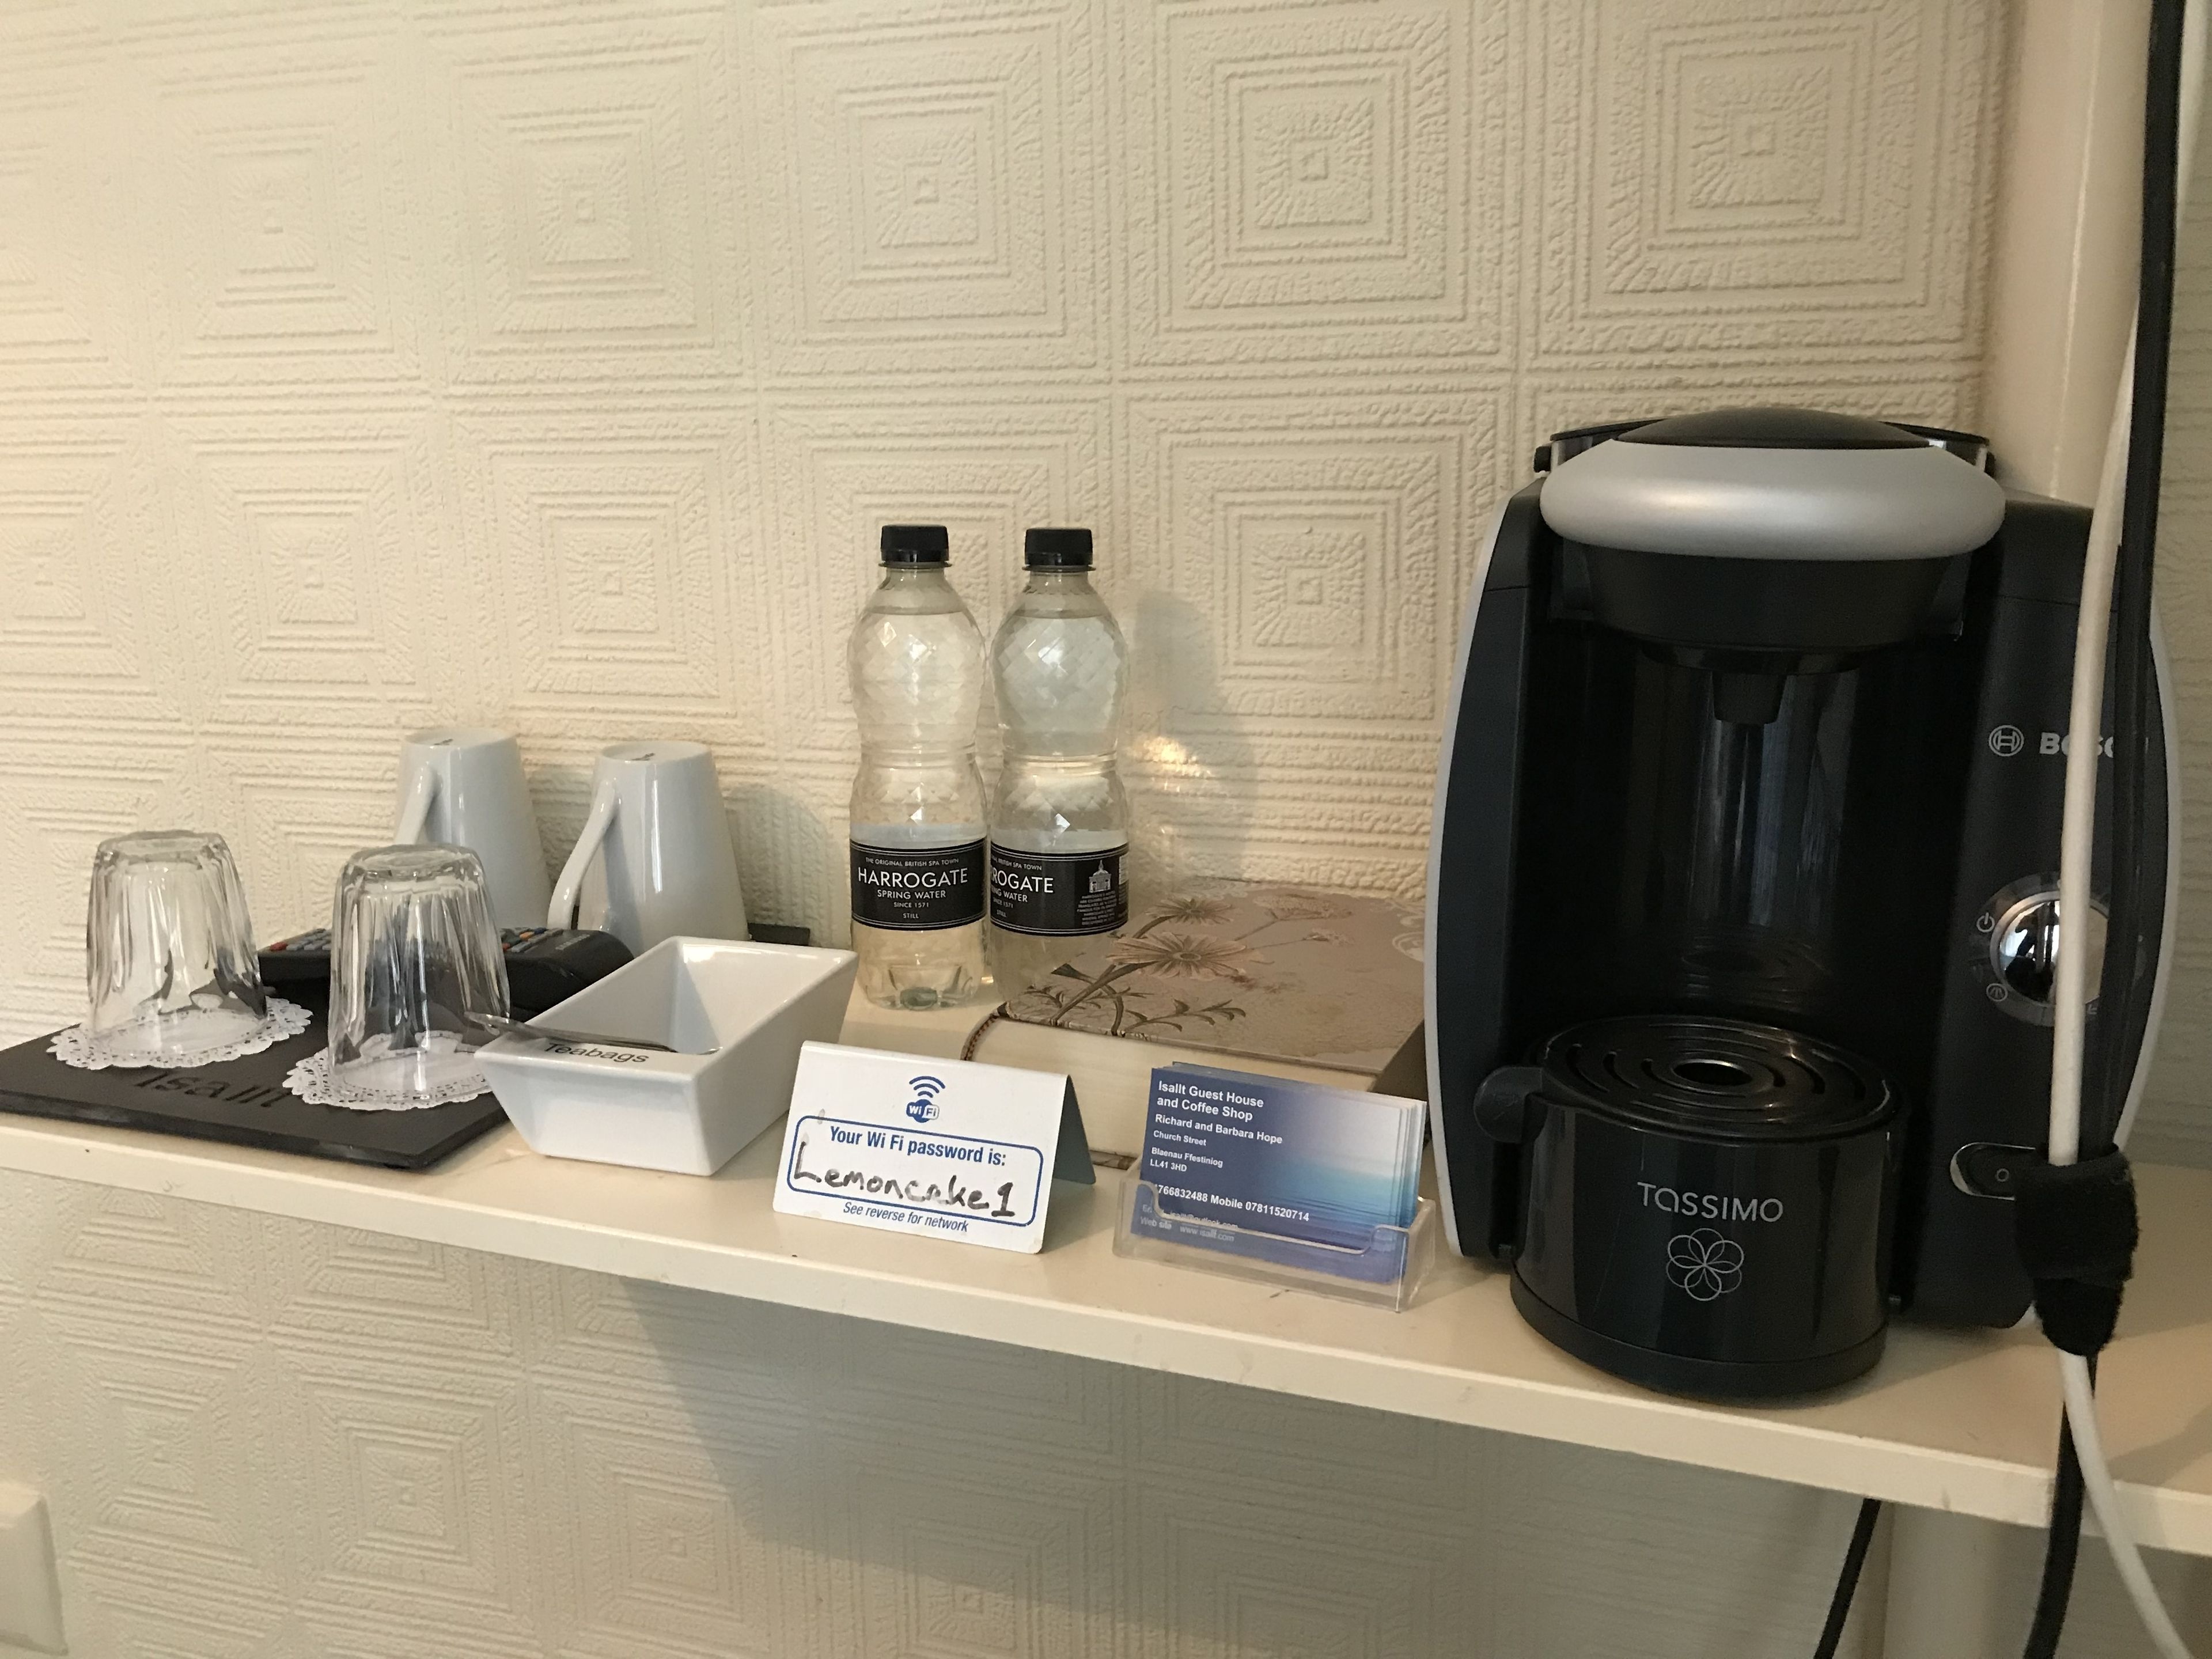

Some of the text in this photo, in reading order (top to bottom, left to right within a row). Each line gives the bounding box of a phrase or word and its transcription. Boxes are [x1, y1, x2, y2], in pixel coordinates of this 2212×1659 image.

[858, 866, 968, 888] HARROGATE
[877, 889, 946, 899] SPRING WATER
[1003, 890, 1028, 903] WATER
[544, 1042, 649, 1063] Teabags
[1158, 1081, 1264, 1108] Isallt Guest House
[1157, 1097, 1253, 1123] and Coffee Shop
[1153, 1130, 1207, 1146] Church Street
[1155, 1113, 1283, 1145] Richard and Barbara Hope
[830, 1126, 1006, 1166] Your Wi Fi password is:
[1150, 1159, 1187, 1172] LL41 3HD
[1151, 1147, 1224, 1169] Blaenau Ffestiniog
[1154, 1184, 1310, 1222] 766832488 Mobile 07811520714
[843, 1202, 968, 1233] See reverse for network
